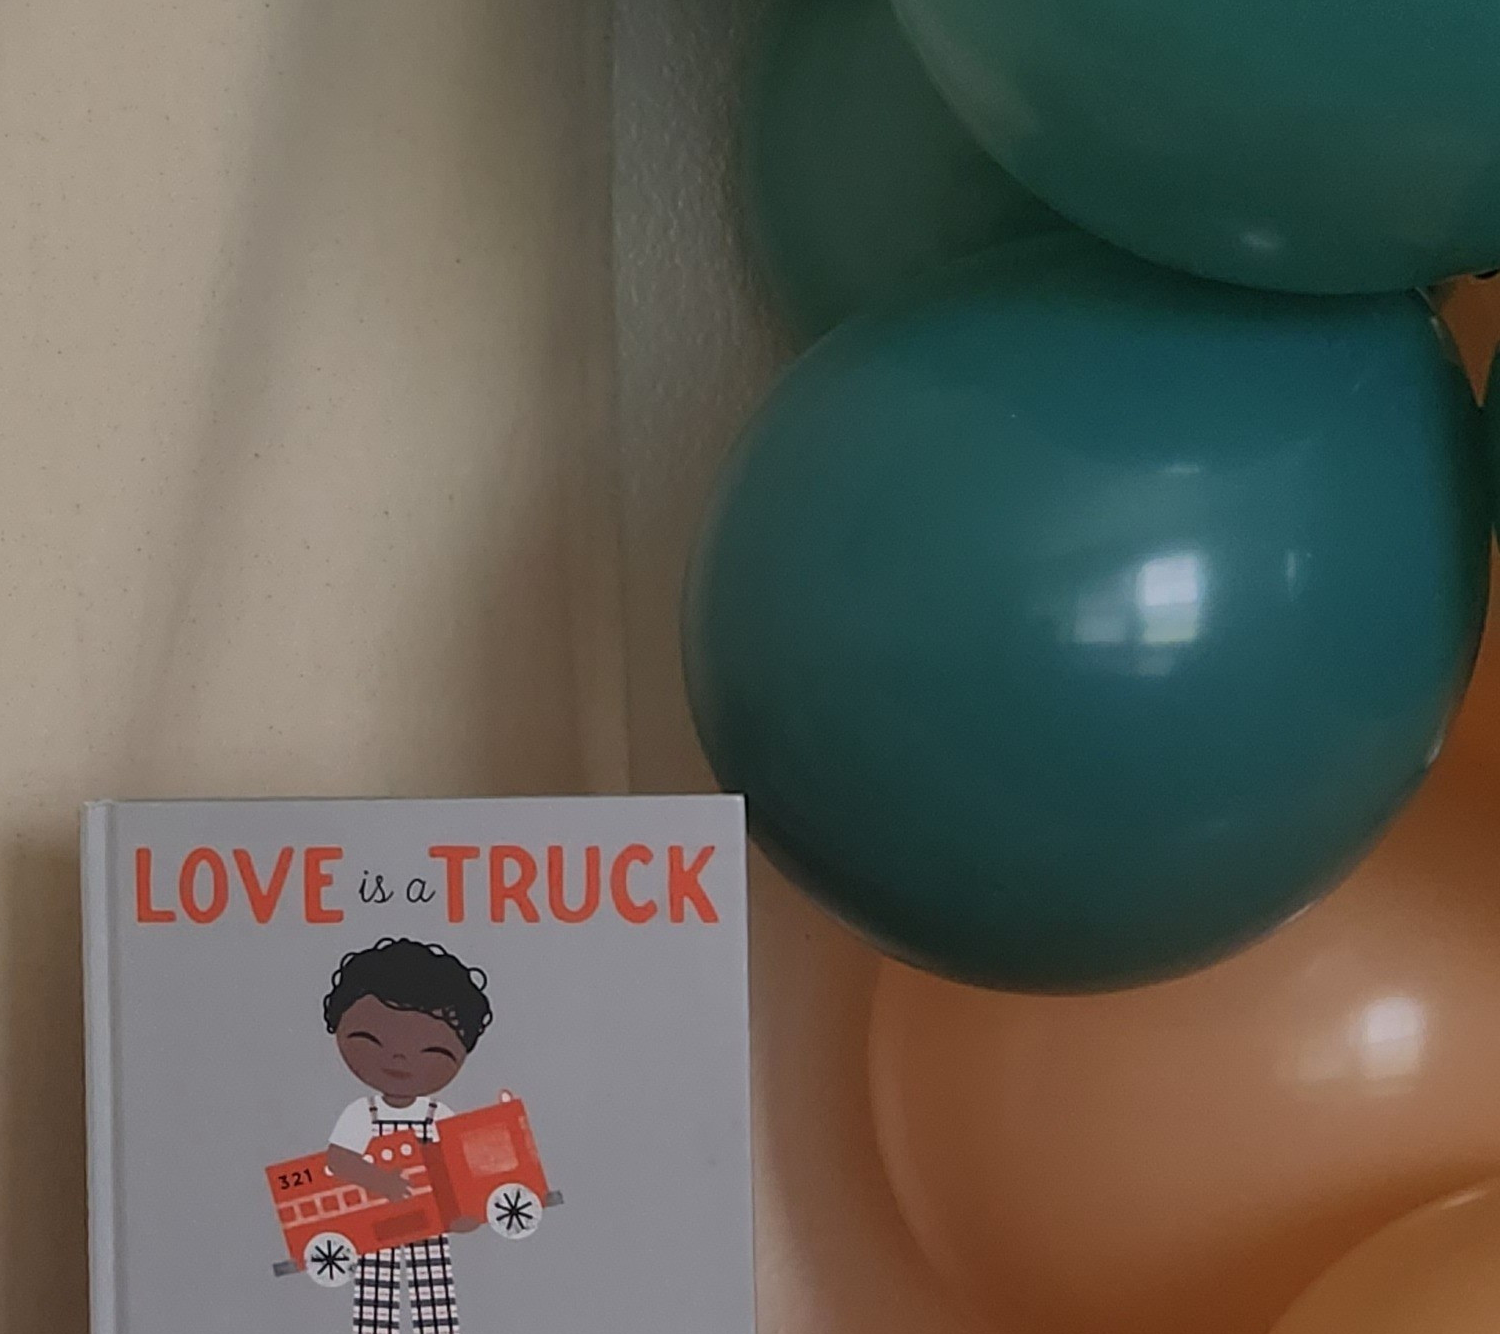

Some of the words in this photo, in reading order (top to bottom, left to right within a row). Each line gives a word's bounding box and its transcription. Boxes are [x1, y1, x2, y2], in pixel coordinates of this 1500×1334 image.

[135, 846, 344, 925] LOVE
[358, 869, 395, 905] is
[405, 877, 437, 905] a
[428, 843, 720, 925] TRUCK
[278, 1168, 313, 1190] 321
